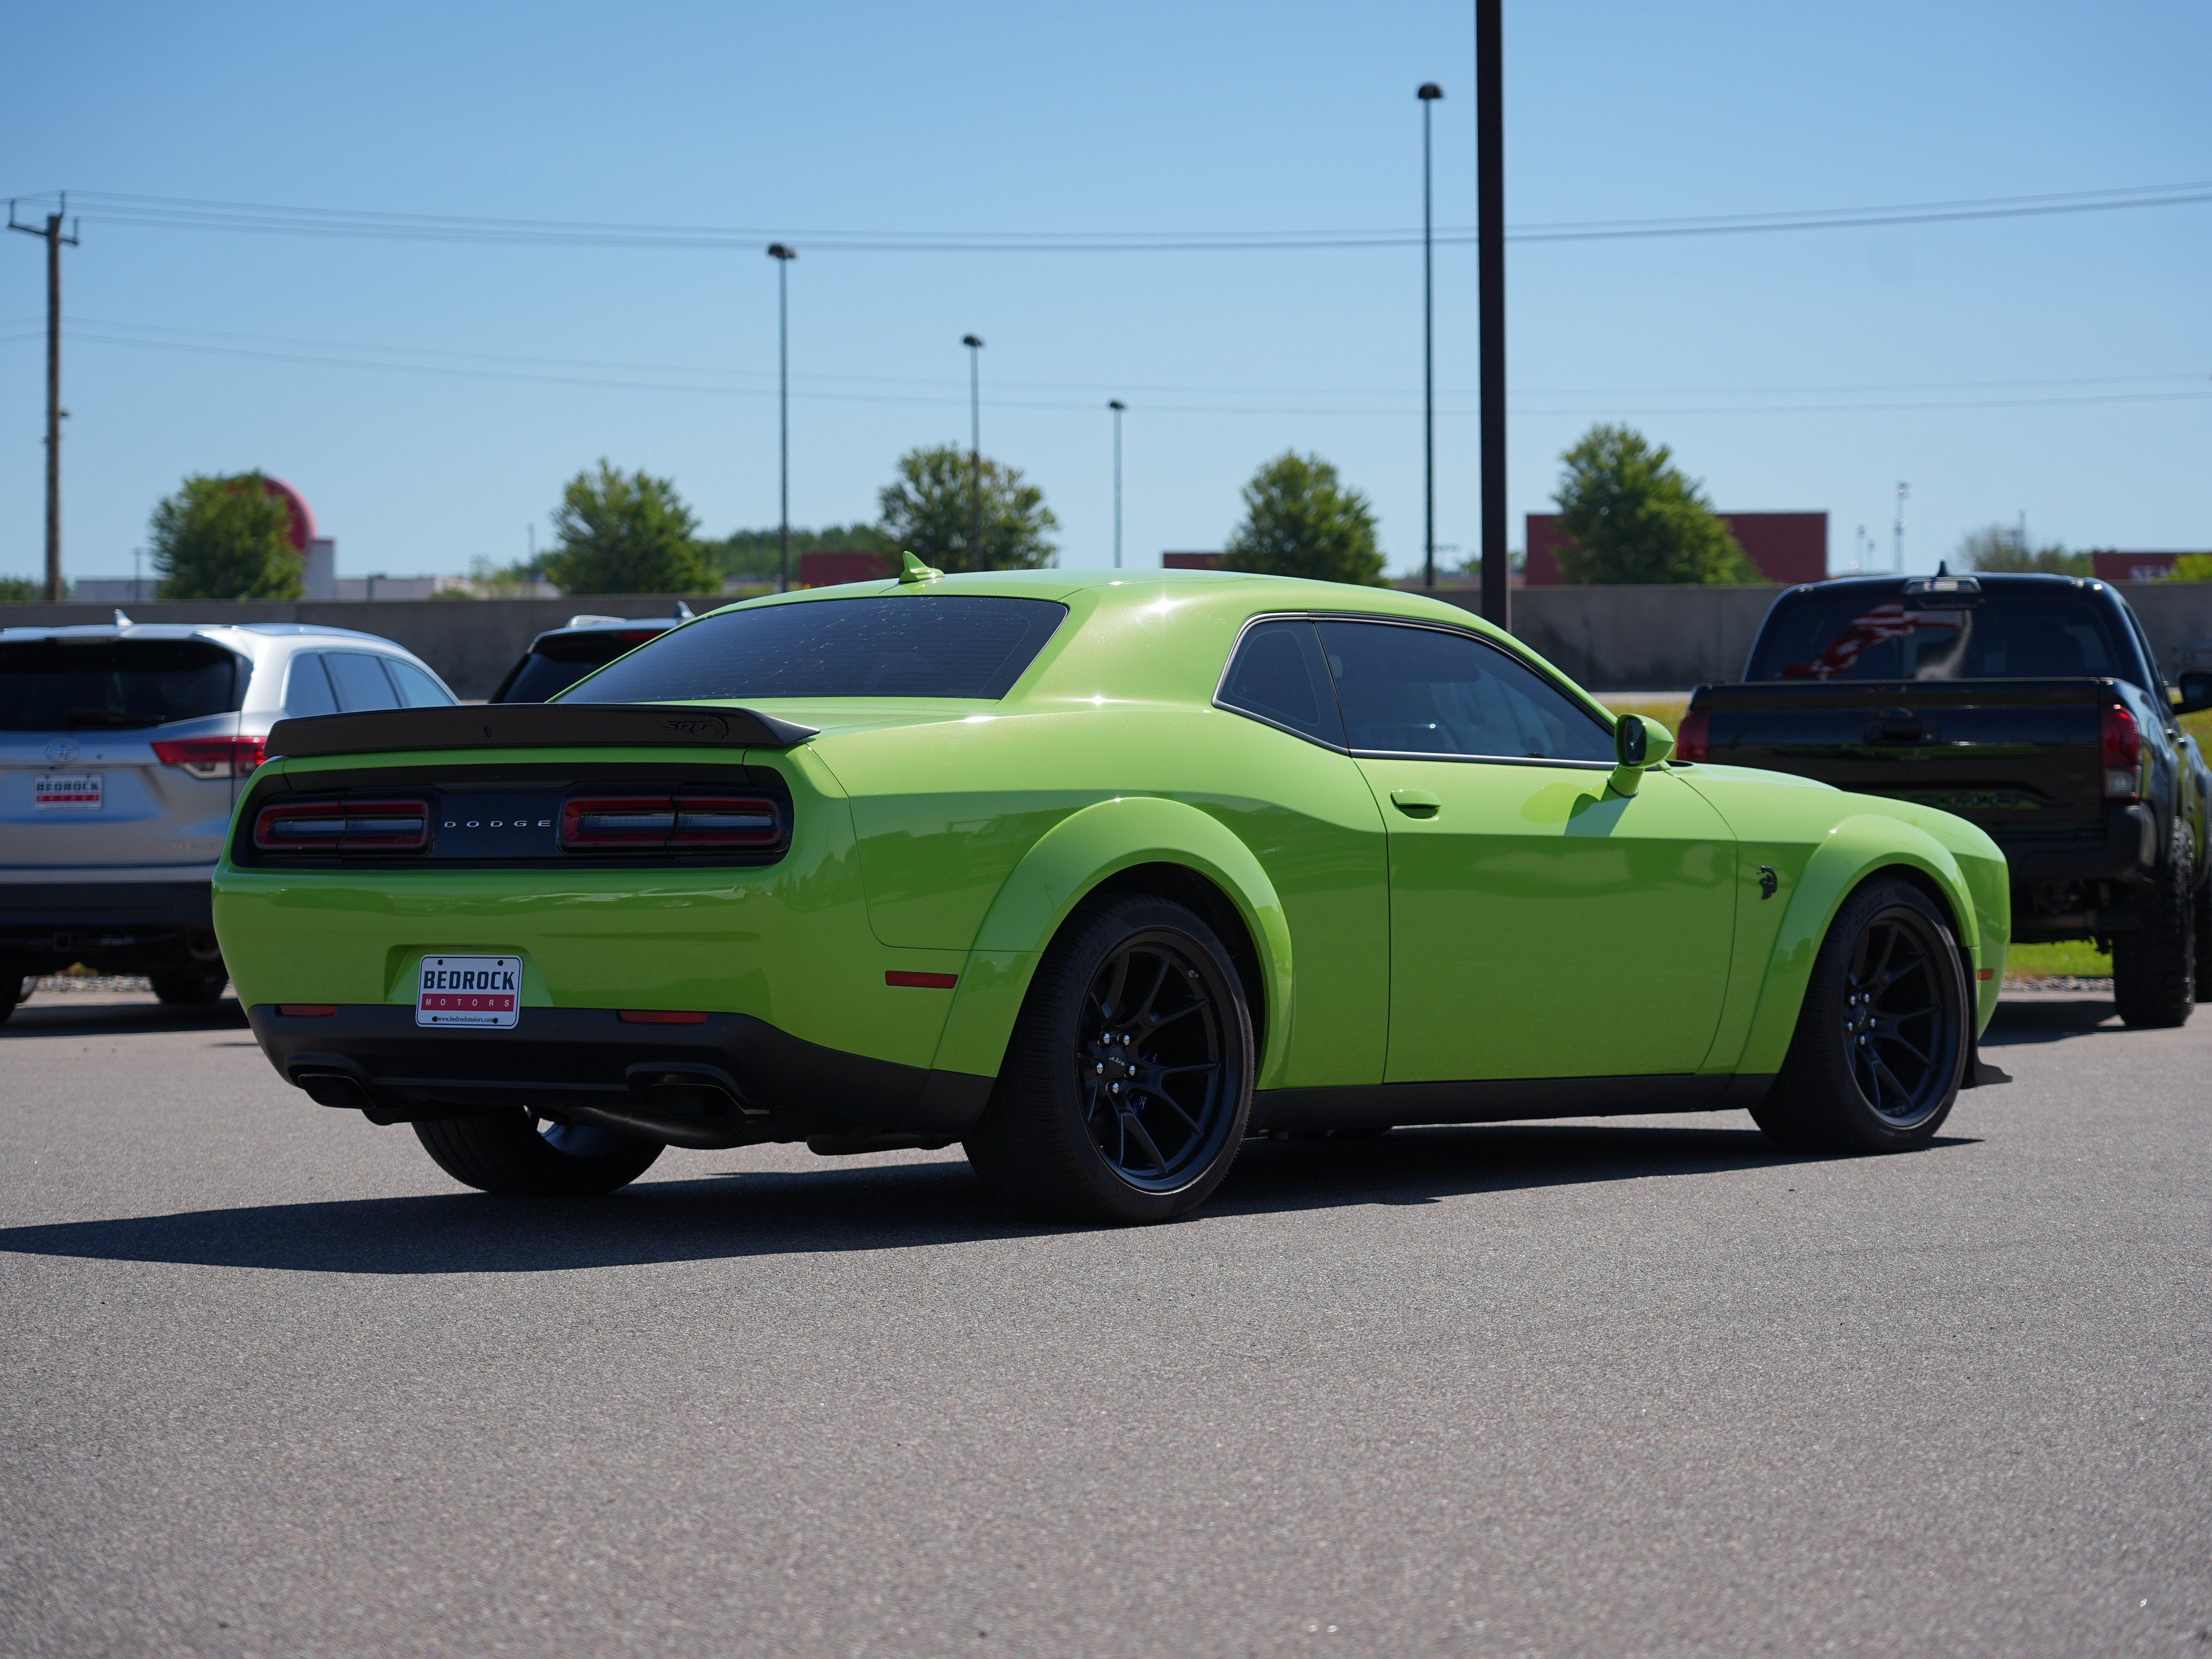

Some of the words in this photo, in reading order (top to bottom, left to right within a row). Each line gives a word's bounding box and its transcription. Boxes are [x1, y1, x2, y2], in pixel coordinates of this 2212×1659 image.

[662, 720, 708, 733] SRT
[444, 820, 551, 828] DODGE
[423, 970, 515, 990] BEDROCK
[426, 998, 509, 1007] MOTORS
